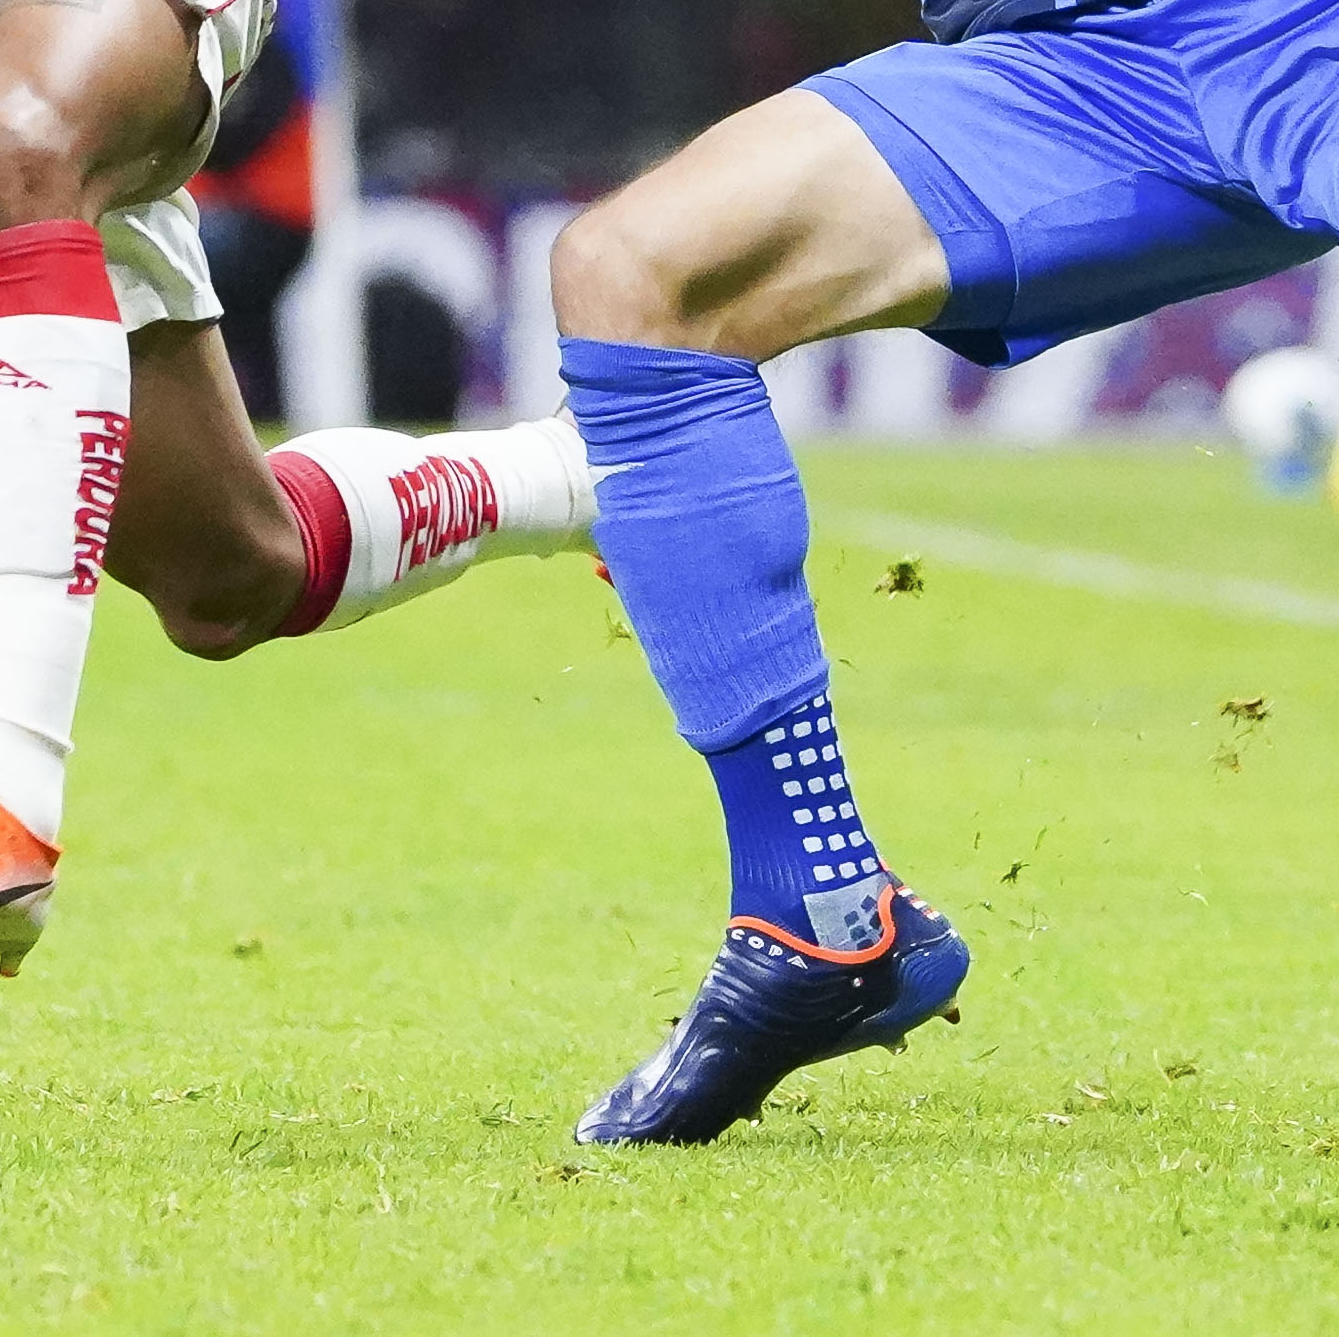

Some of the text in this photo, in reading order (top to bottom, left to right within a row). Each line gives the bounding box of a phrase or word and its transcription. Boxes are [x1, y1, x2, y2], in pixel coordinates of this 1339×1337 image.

[68, 410, 132, 595] PERDURA
[388, 455, 499, 583] PERDURA
[731, 928, 809, 970] COPA
